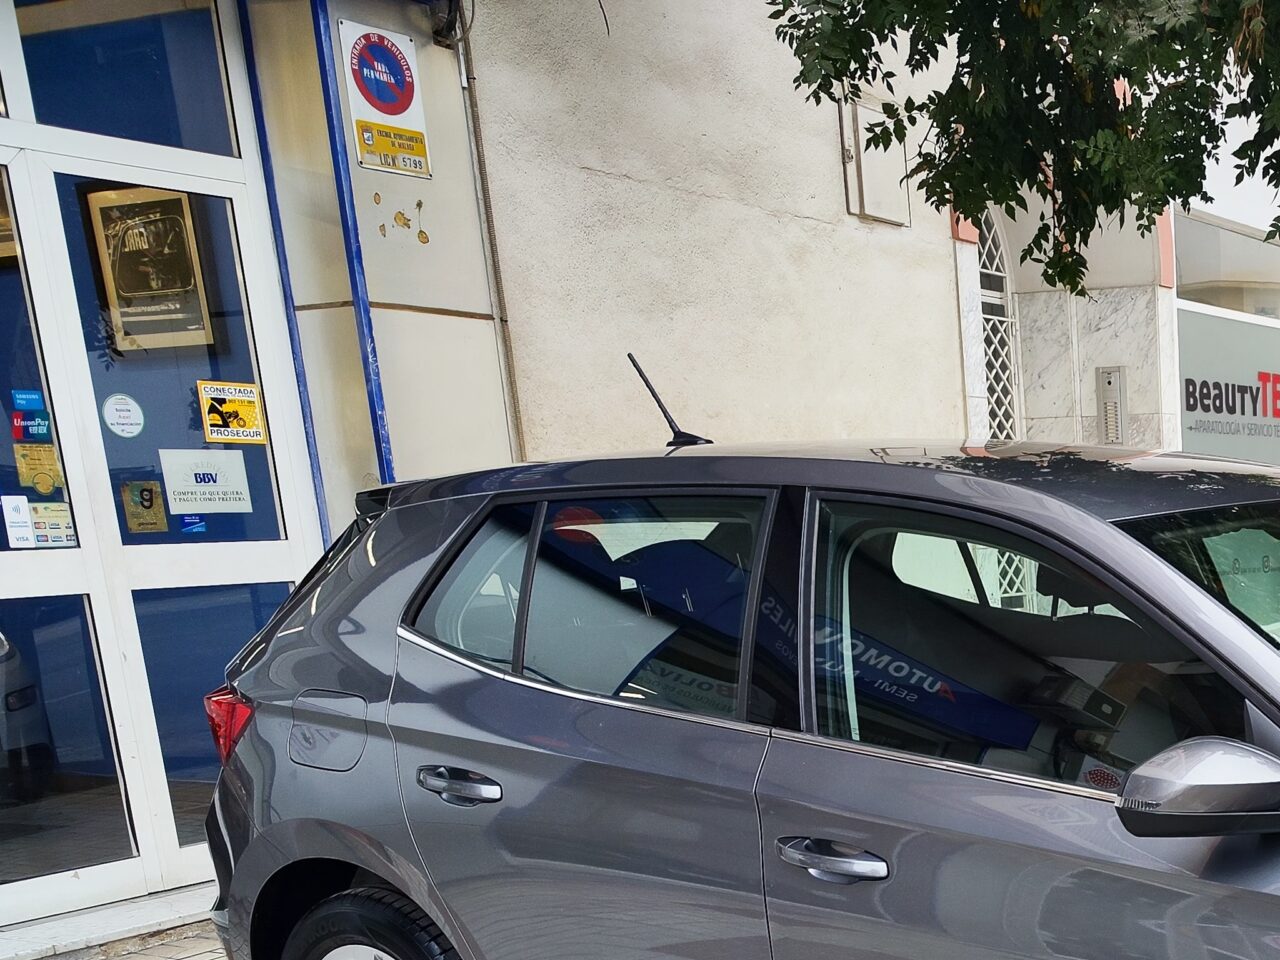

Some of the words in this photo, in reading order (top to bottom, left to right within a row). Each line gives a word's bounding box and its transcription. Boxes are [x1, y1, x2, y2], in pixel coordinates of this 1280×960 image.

[351, 36, 367, 70] ENTRADA
[369, 33, 379, 42] DE
[384, 38, 413, 83] VEHICULOS
[203, 386, 255, 396] CONECTADA
[14, 418, 48, 427] UnionPay
[210, 428, 262, 438] PROSEGUR
[1247, 422, 1273, 438] SERVICIO
[193, 472, 218, 484] BBV
